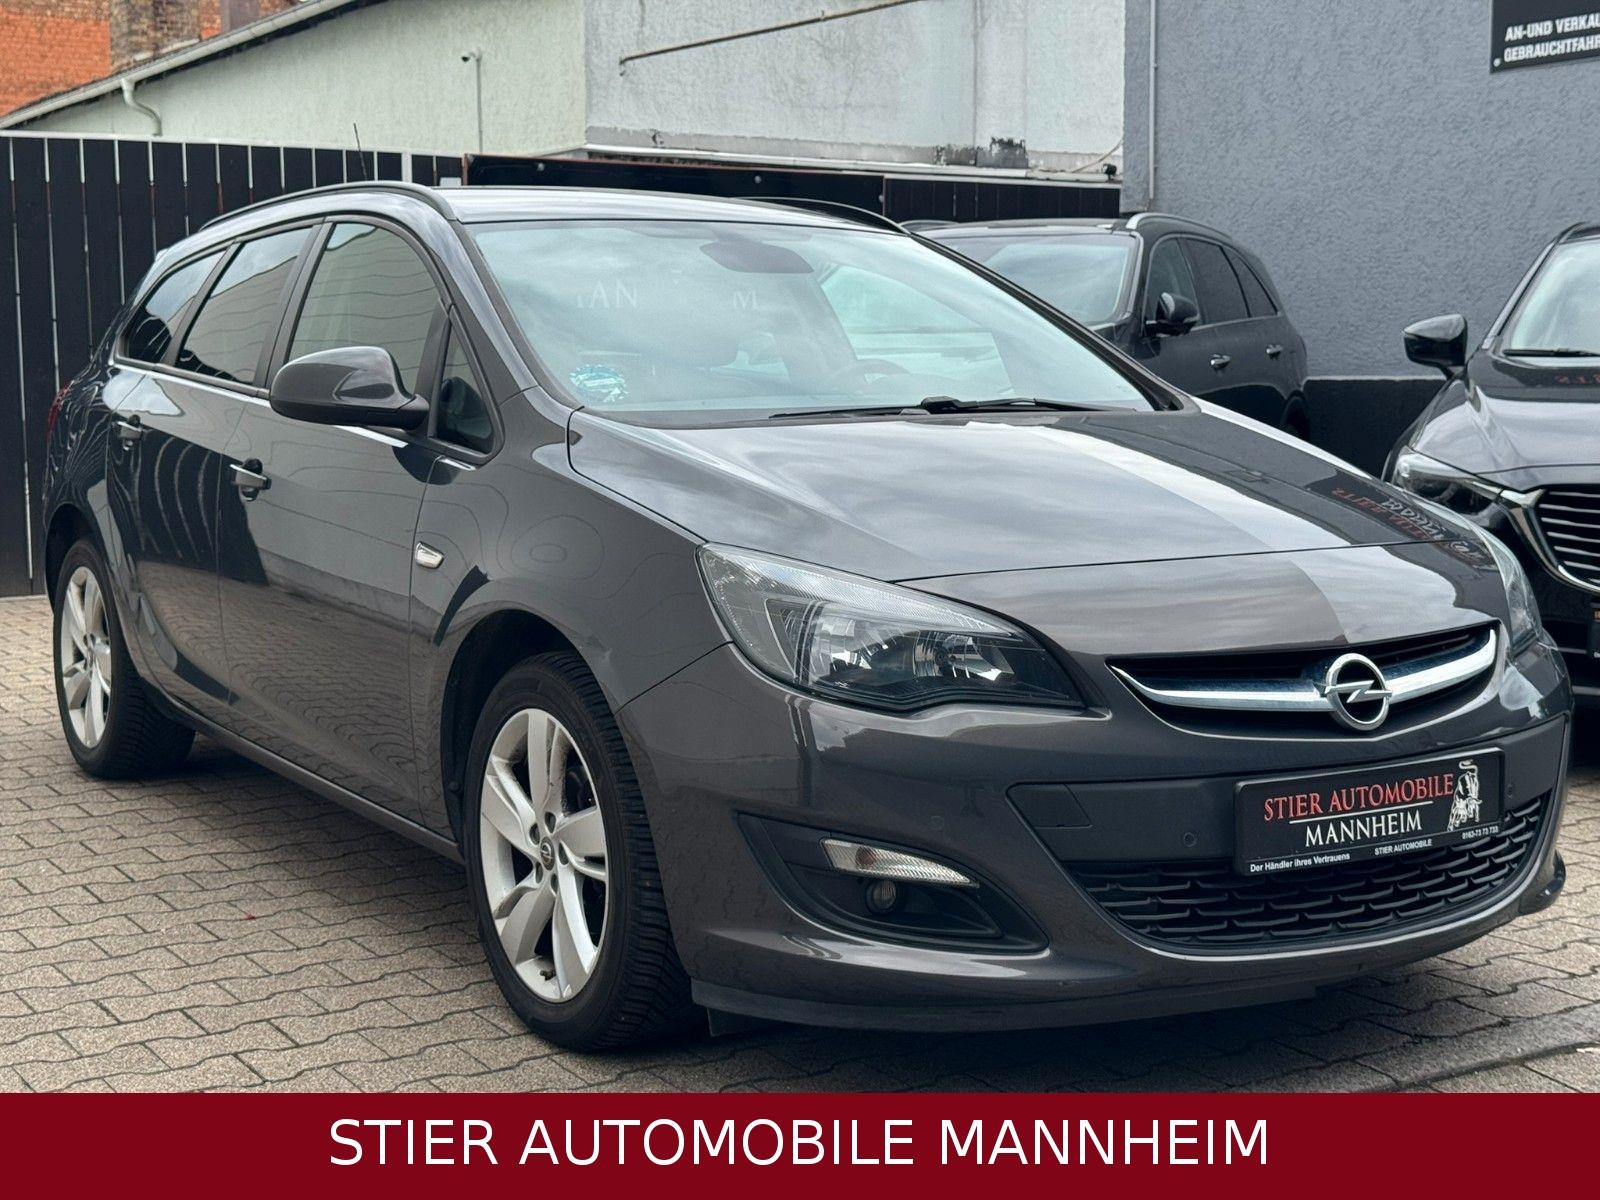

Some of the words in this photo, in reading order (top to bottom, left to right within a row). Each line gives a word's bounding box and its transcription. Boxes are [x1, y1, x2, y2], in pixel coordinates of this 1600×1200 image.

[1505, 20, 1553, 41] AN-UND
[1264, 793, 1323, 821] STIER
[1329, 773, 1454, 813] AUTOMOBILE
[1305, 810, 1422, 847] MANNHEIM
[1374, 845, 1394, 856] STIER
[1393, 838, 1433, 853] AUTOMOBILE
[1250, 863, 1263, 873] Der
[1264, 861, 1293, 871] Händler
[1312, 852, 1351, 865] Vertrauens
